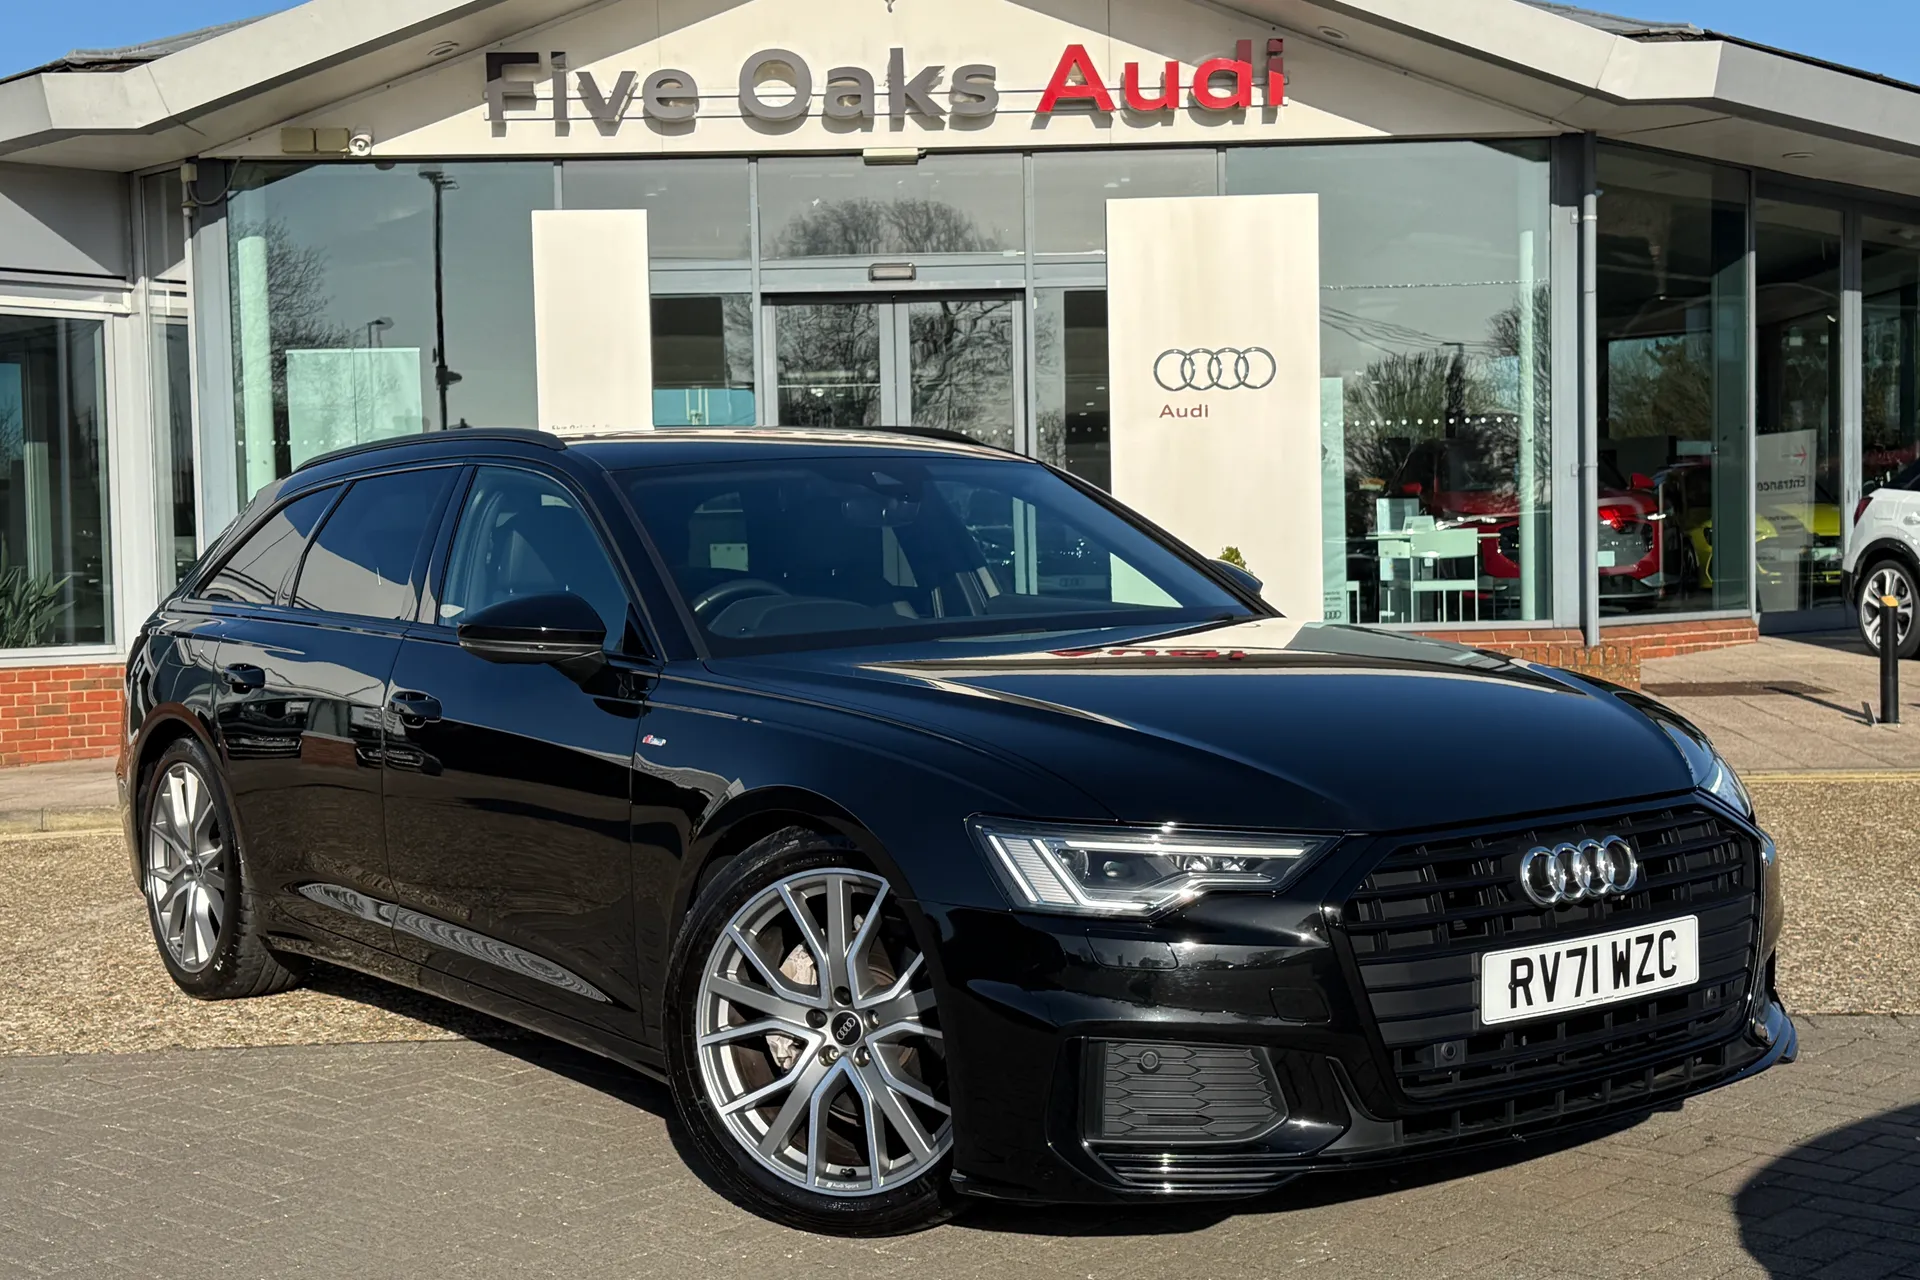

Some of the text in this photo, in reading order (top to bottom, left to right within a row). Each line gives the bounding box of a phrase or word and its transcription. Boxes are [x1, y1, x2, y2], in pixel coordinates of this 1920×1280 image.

[486, 38, 1284, 123] Five Oaks Audi
[1159, 403, 1208, 418] Audi
[1509, 929, 1677, 1009] RV71 WZC
